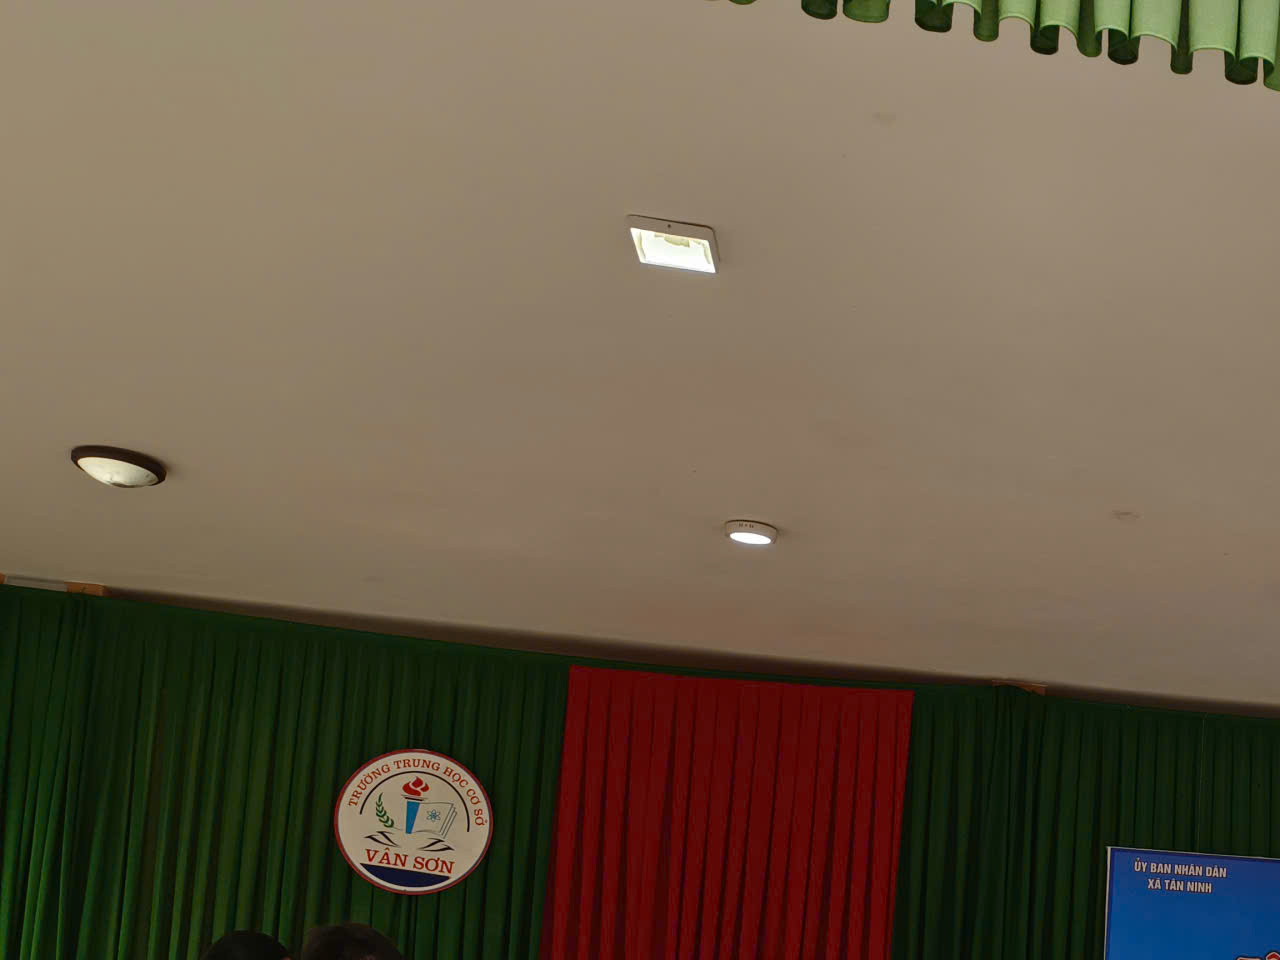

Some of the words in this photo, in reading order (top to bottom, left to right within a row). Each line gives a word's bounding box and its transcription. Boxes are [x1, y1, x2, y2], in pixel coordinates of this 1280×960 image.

[393, 758, 441, 771] TRUNG
[348, 764, 391, 808] TRƯỜNG
[442, 766, 469, 789] HỌC
[466, 788, 481, 805] CƠ
[473, 809, 488, 826] SỞ
[365, 847, 408, 867] VÂN
[413, 855, 455, 874] SƠN
[1150, 863, 1171, 874] BAN
[1174, 864, 1202, 876] NHÂN
[1206, 865, 1227, 878] DÂN
[1148, 877, 1161, 889] XÃ
[1164, 878, 1184, 891] TÂN
[1187, 881, 1212, 893] NINH
